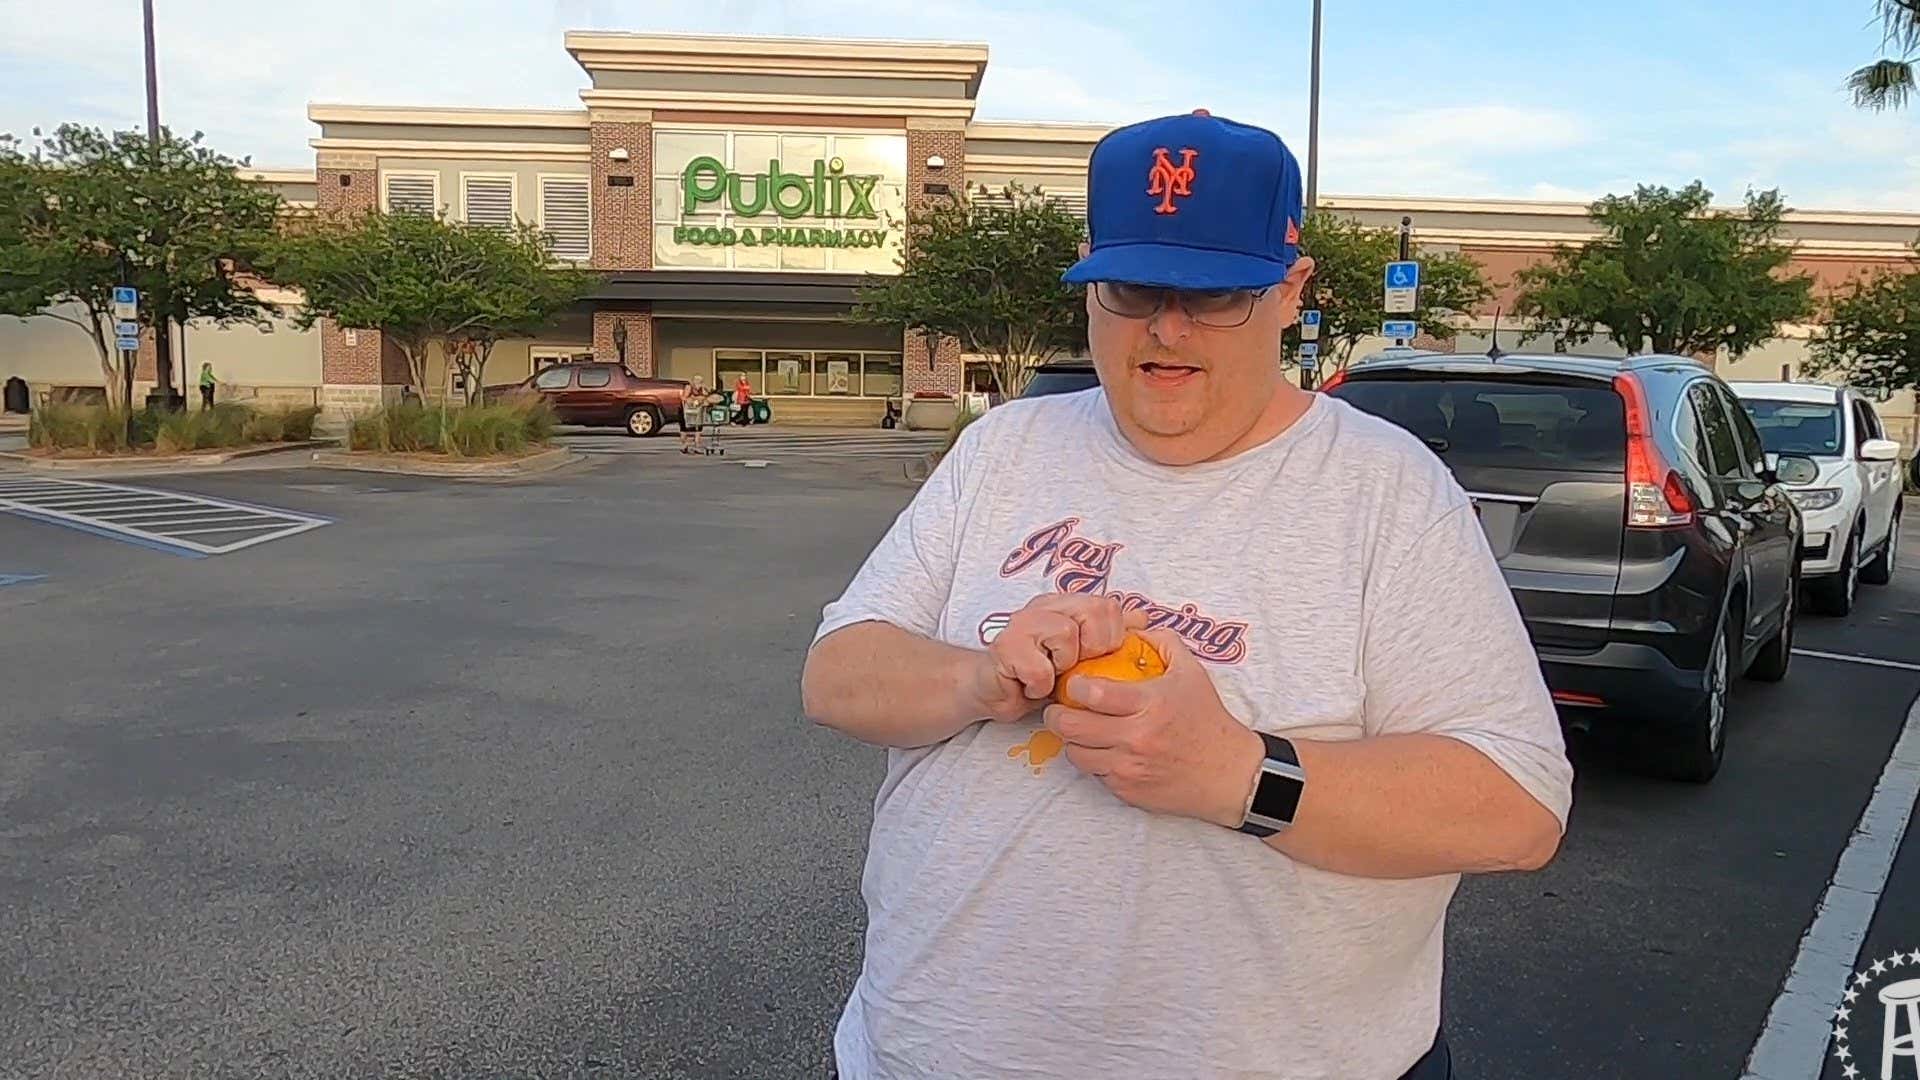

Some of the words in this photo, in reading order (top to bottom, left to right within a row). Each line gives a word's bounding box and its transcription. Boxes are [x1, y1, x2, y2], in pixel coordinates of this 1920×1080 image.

[683, 156, 880, 220] Publix
[673, 226, 737, 246] FOOD
[740, 228, 757, 247] &
[761, 228, 887, 248] PHARMACY
